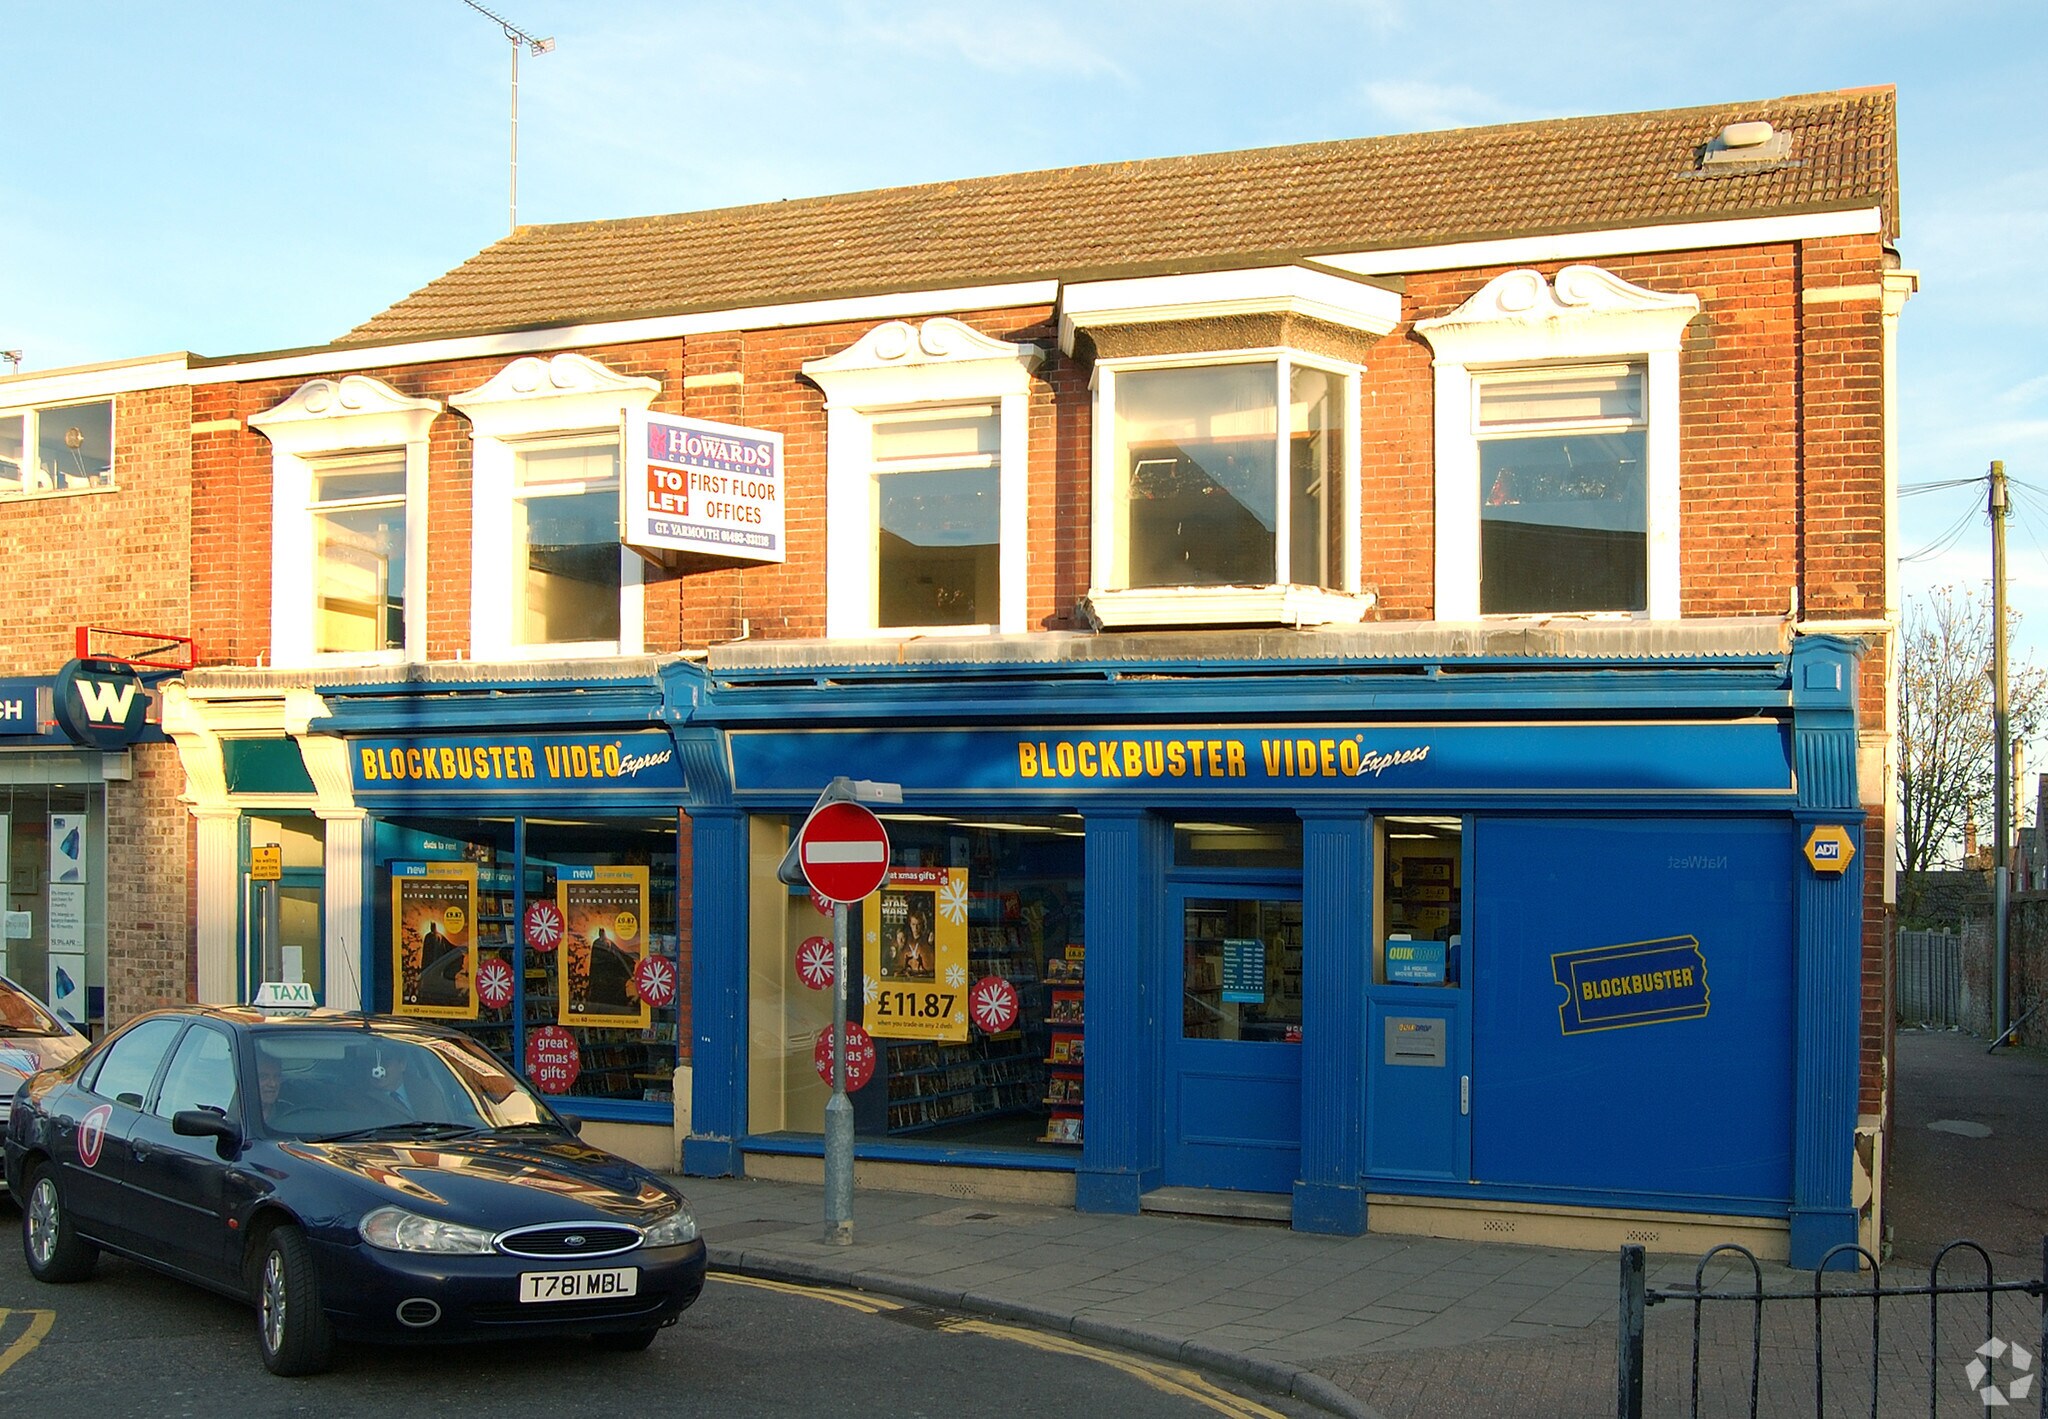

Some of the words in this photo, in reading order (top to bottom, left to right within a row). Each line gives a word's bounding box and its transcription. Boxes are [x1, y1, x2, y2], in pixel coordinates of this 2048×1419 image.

[668, 429, 771, 467] HOWARDS
[668, 454, 771, 477] COMMERCIAL
[653, 469, 683, 491] TO
[690, 473, 728, 494] FIRST
[732, 479, 776, 501] FLOOR
[649, 491, 688, 513] LET
[706, 501, 762, 524] OFFICES
[670, 523, 720, 541] YARMOUTH
[0, 699, 22, 720] H
[75, 679, 137, 724] W
[361, 746, 536, 780] BLOCKBUSTER
[544, 744, 620, 779] VIDEO
[617, 750, 672, 778] Express
[1017, 740, 1247, 778] BLOCKBUSTER
[1261, 739, 1360, 777] VIDEO
[1355, 744, 1431, 778] Express
[1815, 843, 1839, 856] ADT
[406, 865, 426, 874] new
[572, 869, 593, 879] new
[898, 872, 918, 880] xmas
[918, 871, 936, 881] gifts
[882, 899, 909, 907] STAR
[882, 907, 909, 915] WARS
[1581, 966, 1695, 1001] BLOCKBUSTER
[269, 984, 309, 1001] TAXI
[877, 990, 955, 1018] £11.87
[537, 1037, 569, 1051] great
[827, 1033, 863, 1047] gat
[538, 1053, 569, 1064] xmas
[827, 1049, 862, 1062] xas
[540, 1065, 567, 1081] gifts
[530, 1275, 581, 1297] T781
[586, 1272, 629, 1294] MBL
